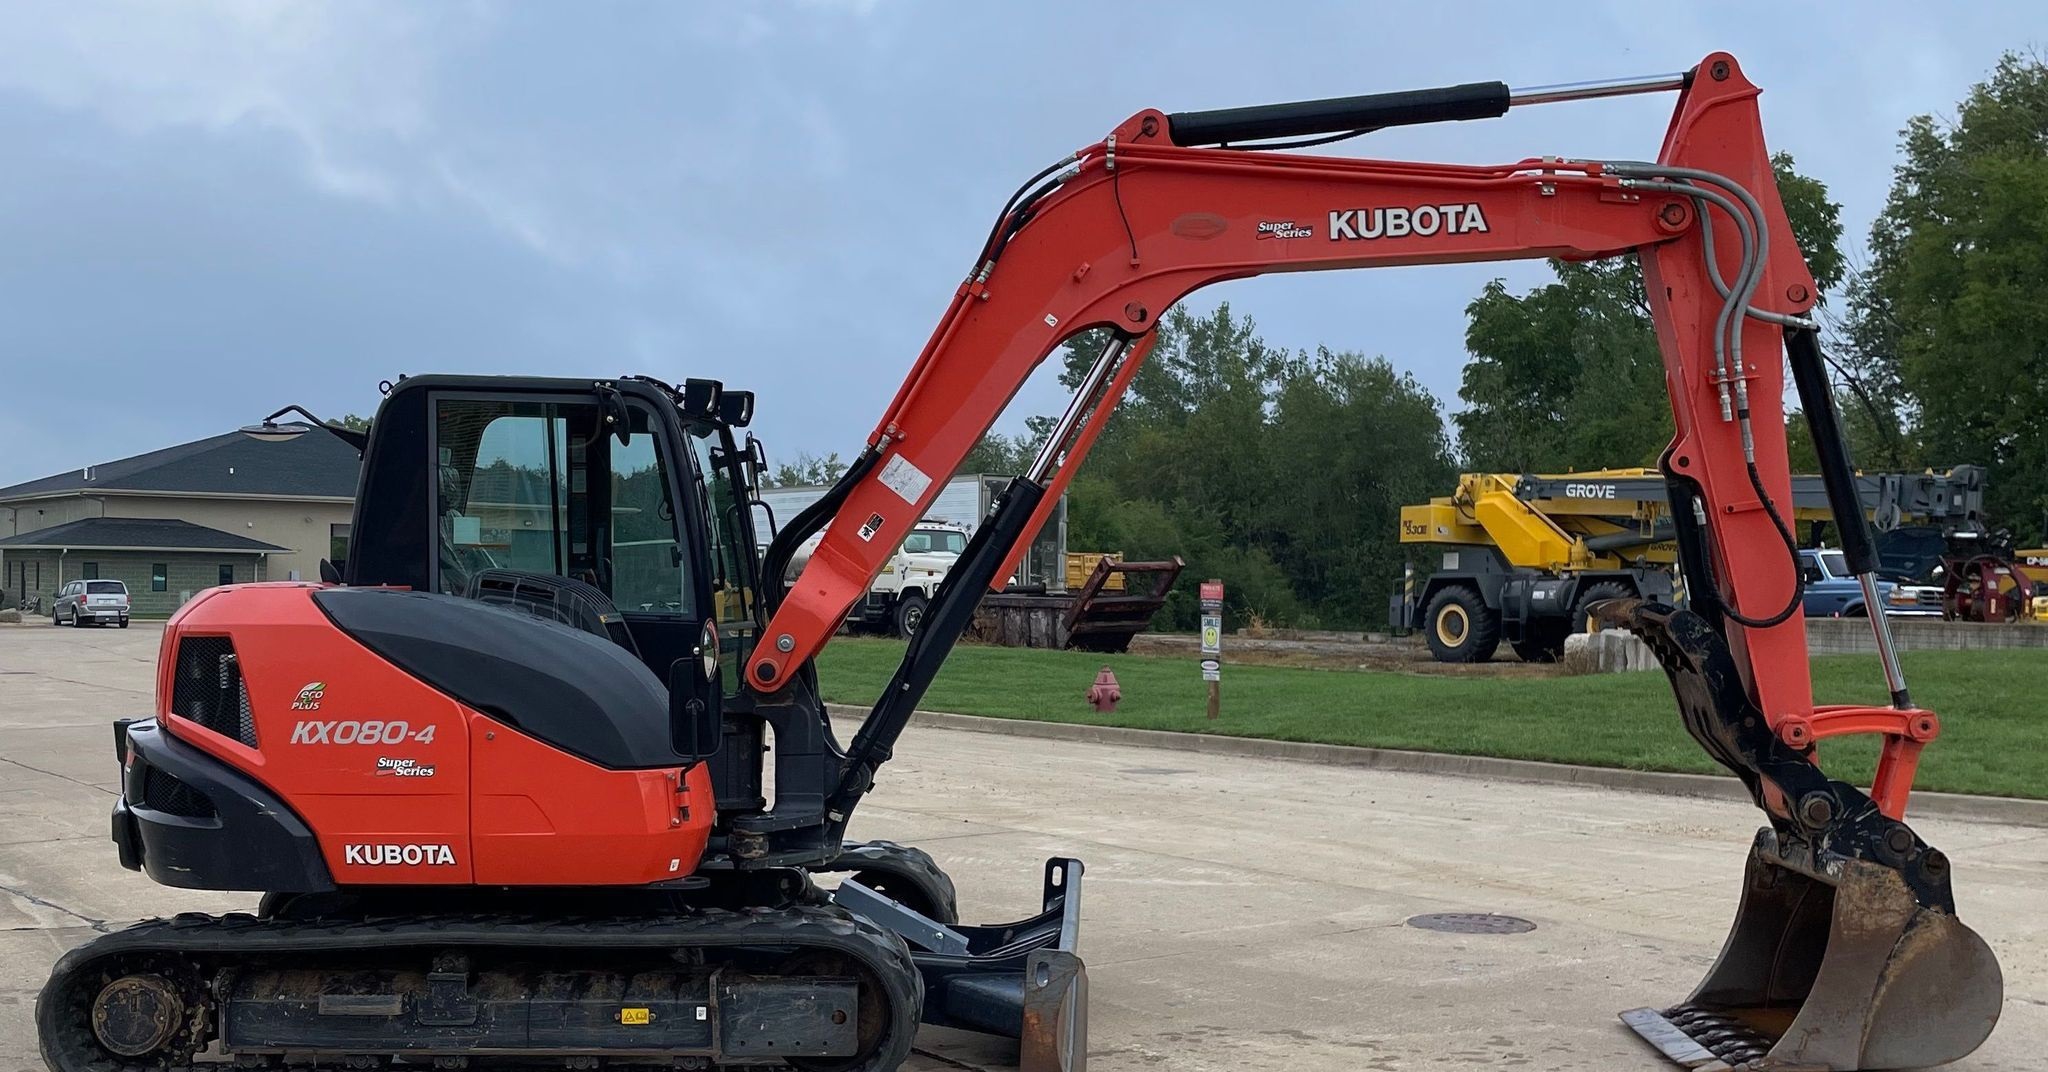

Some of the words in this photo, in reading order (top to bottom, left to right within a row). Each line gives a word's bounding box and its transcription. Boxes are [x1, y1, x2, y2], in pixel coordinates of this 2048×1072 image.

[1258, 221, 1294, 232] Super
[1329, 203, 1488, 240] KUBOTA
[1275, 227, 1312, 239] Series
[1565, 483, 1616, 499] GROVE
[301, 690, 323, 699] eco
[291, 701, 320, 711] PLUS
[290, 720, 436, 745] KX080-4
[377, 757, 416, 770] Super
[395, 766, 434, 777] Series
[345, 844, 456, 865] KUBOTA
